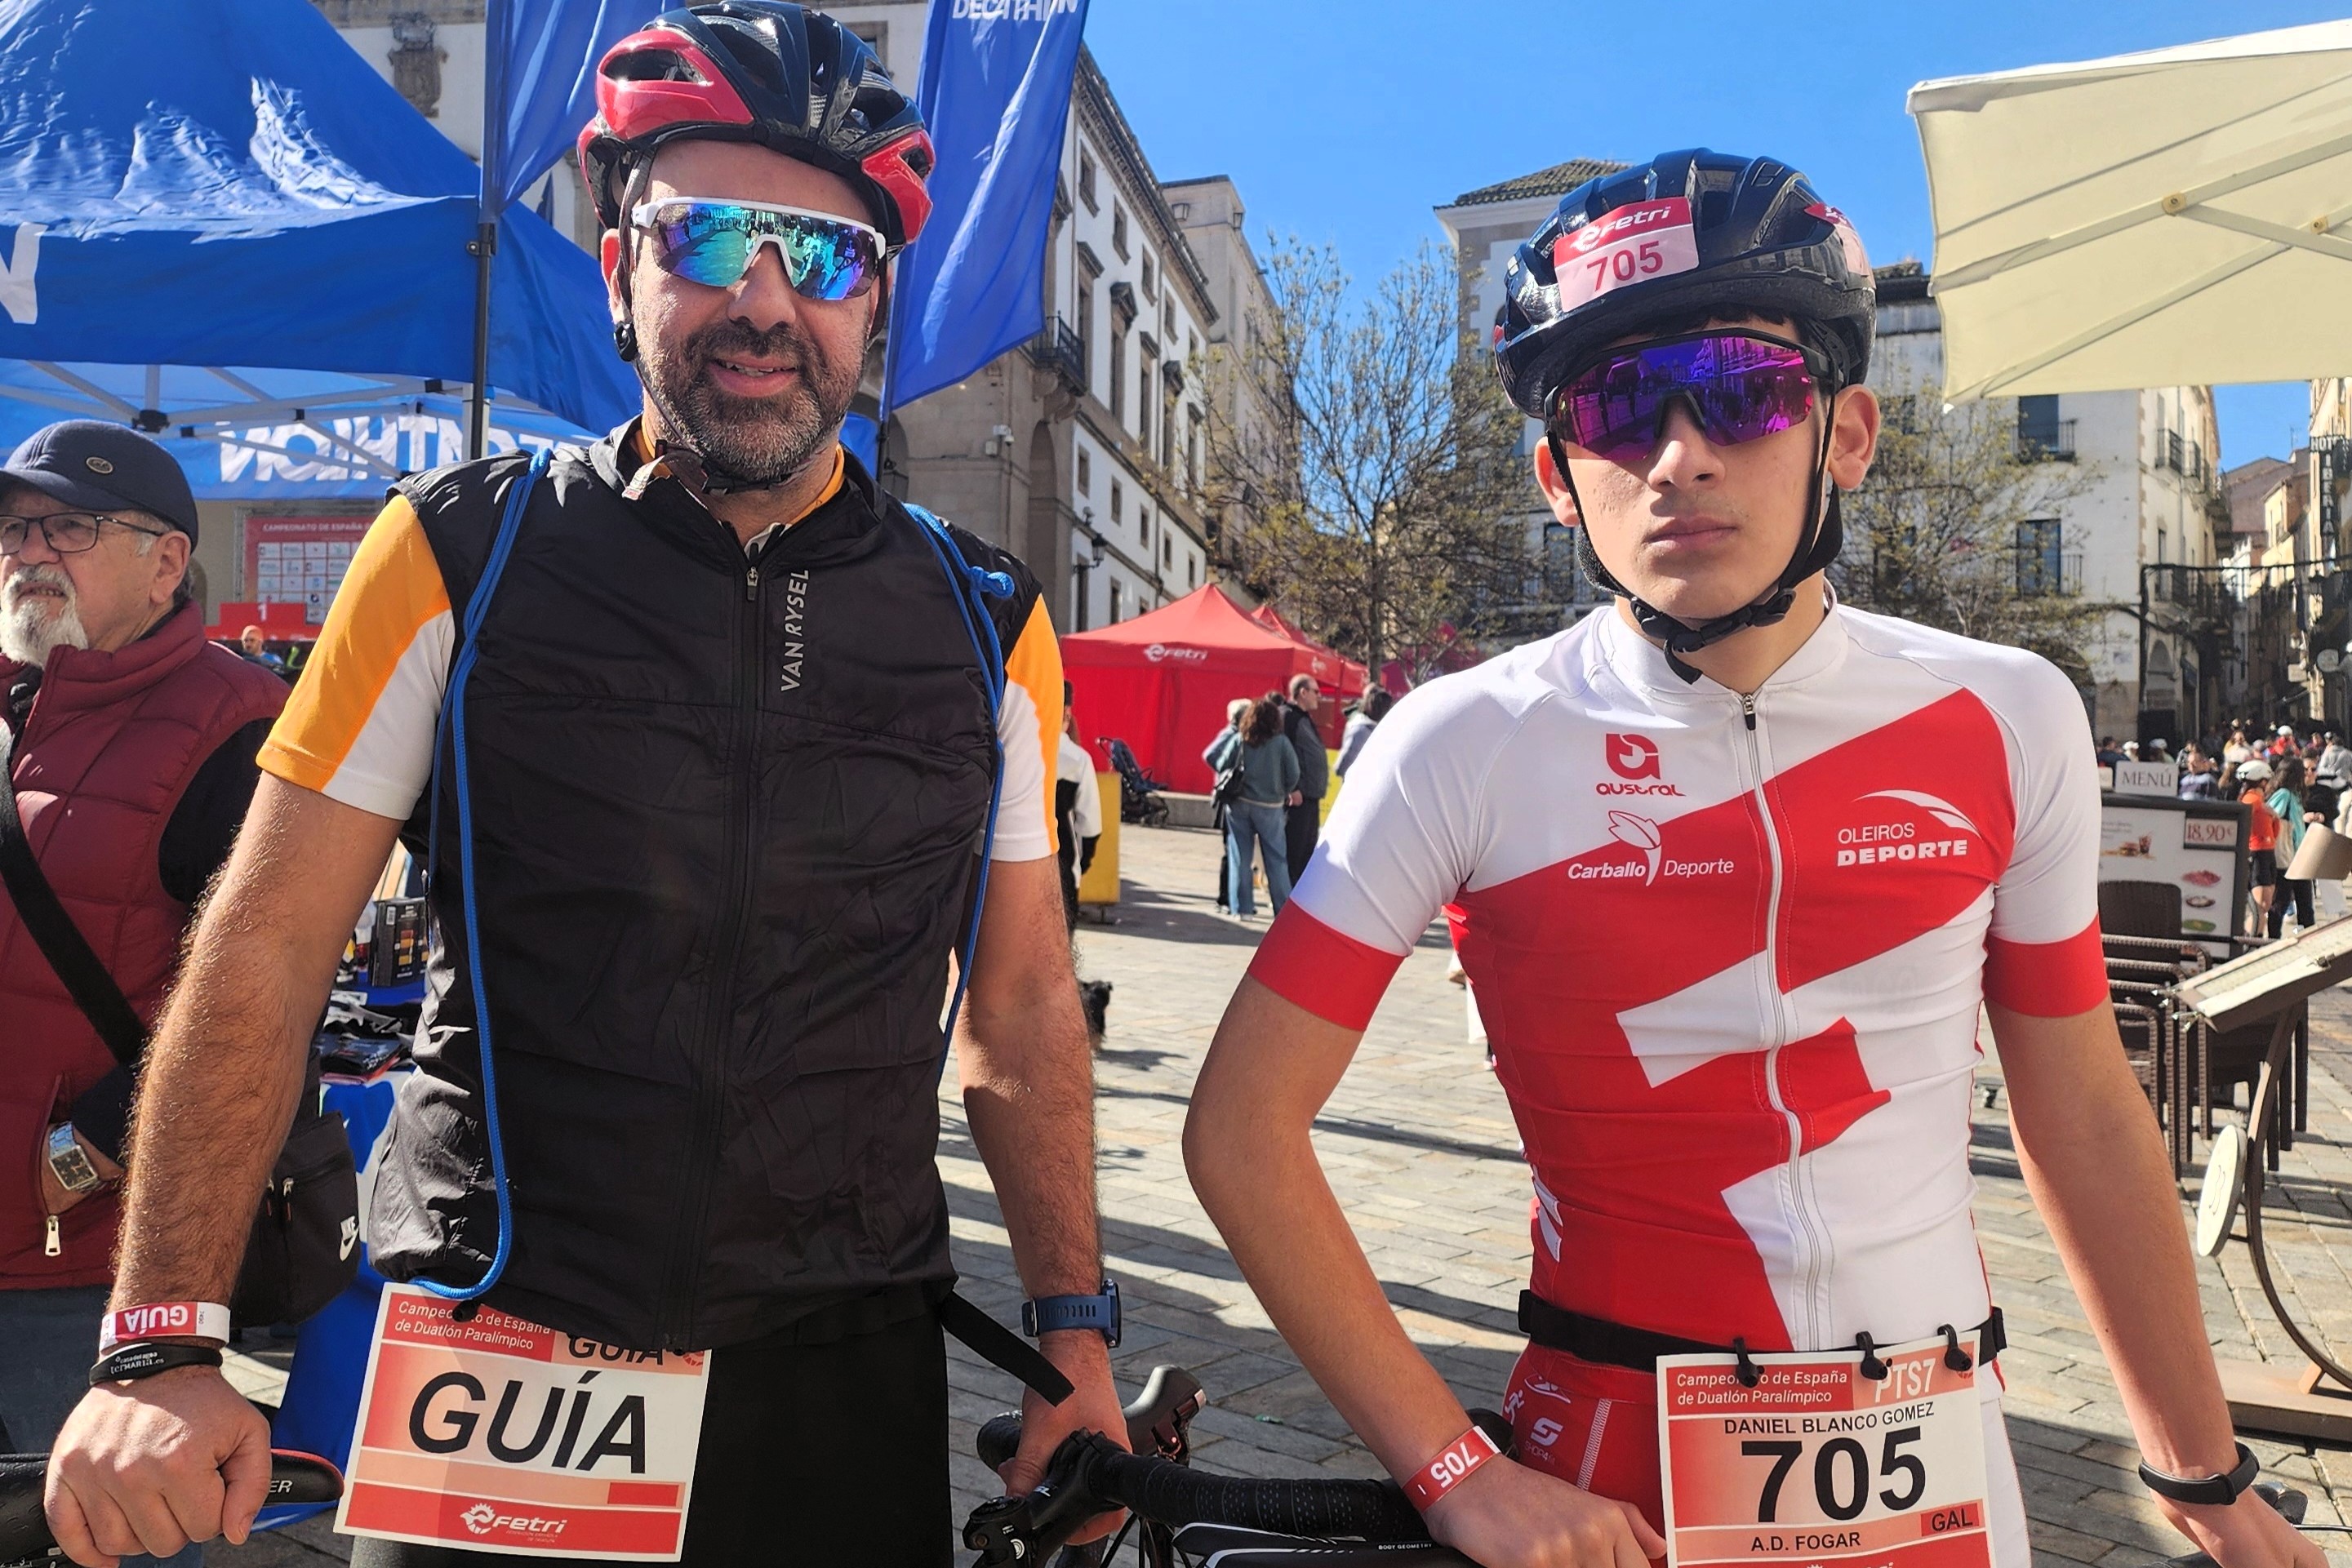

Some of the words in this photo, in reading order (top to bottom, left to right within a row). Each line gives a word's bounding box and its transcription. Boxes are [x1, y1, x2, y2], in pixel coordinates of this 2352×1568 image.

[1587, 241, 1663, 291] 705
[785, 570, 809, 637] RYSEL
[780, 642, 804, 691] VAN
[1595, 782, 1687, 797] austral
[2121, 767, 2172, 788] MENÚ
[1838, 822, 1915, 844] OLEIROS
[1837, 839, 1967, 867] DEPORTE
[1567, 861, 1647, 880] Carballo
[1663, 858, 1735, 878] Deporte
[124, 1304, 189, 1335] GUÍA
[398, 1300, 483, 1324] Campeoo
[486, 1313, 501, 1326] de
[394, 1318, 411, 1332] de
[413, 1320, 462, 1339] Duatlón
[464, 1327, 534, 1350] Paralímpico
[1677, 1373, 1769, 1388] Campeoo
[1772, 1372, 1790, 1384] de
[1794, 1370, 1847, 1388] España
[1874, 1357, 1936, 1403] PTS7
[1678, 1393, 1694, 1406] de
[1697, 1389, 1749, 1405] Duatlón
[1752, 1389, 1832, 1406] Paralímpico
[409, 1370, 646, 1474] GUÍA
[1724, 1419, 1796, 1435] DANIEL
[1802, 1414, 1878, 1434] BLANCO
[1882, 1401, 1935, 1425] GOMEZ
[1430, 1441, 1480, 1488] 705
[1741, 1425, 1926, 1523] 705
[1932, 1508, 1973, 1531] GAL
[1751, 1536, 1789, 1552] A.D.
[1795, 1531, 1861, 1551] FOGAR
